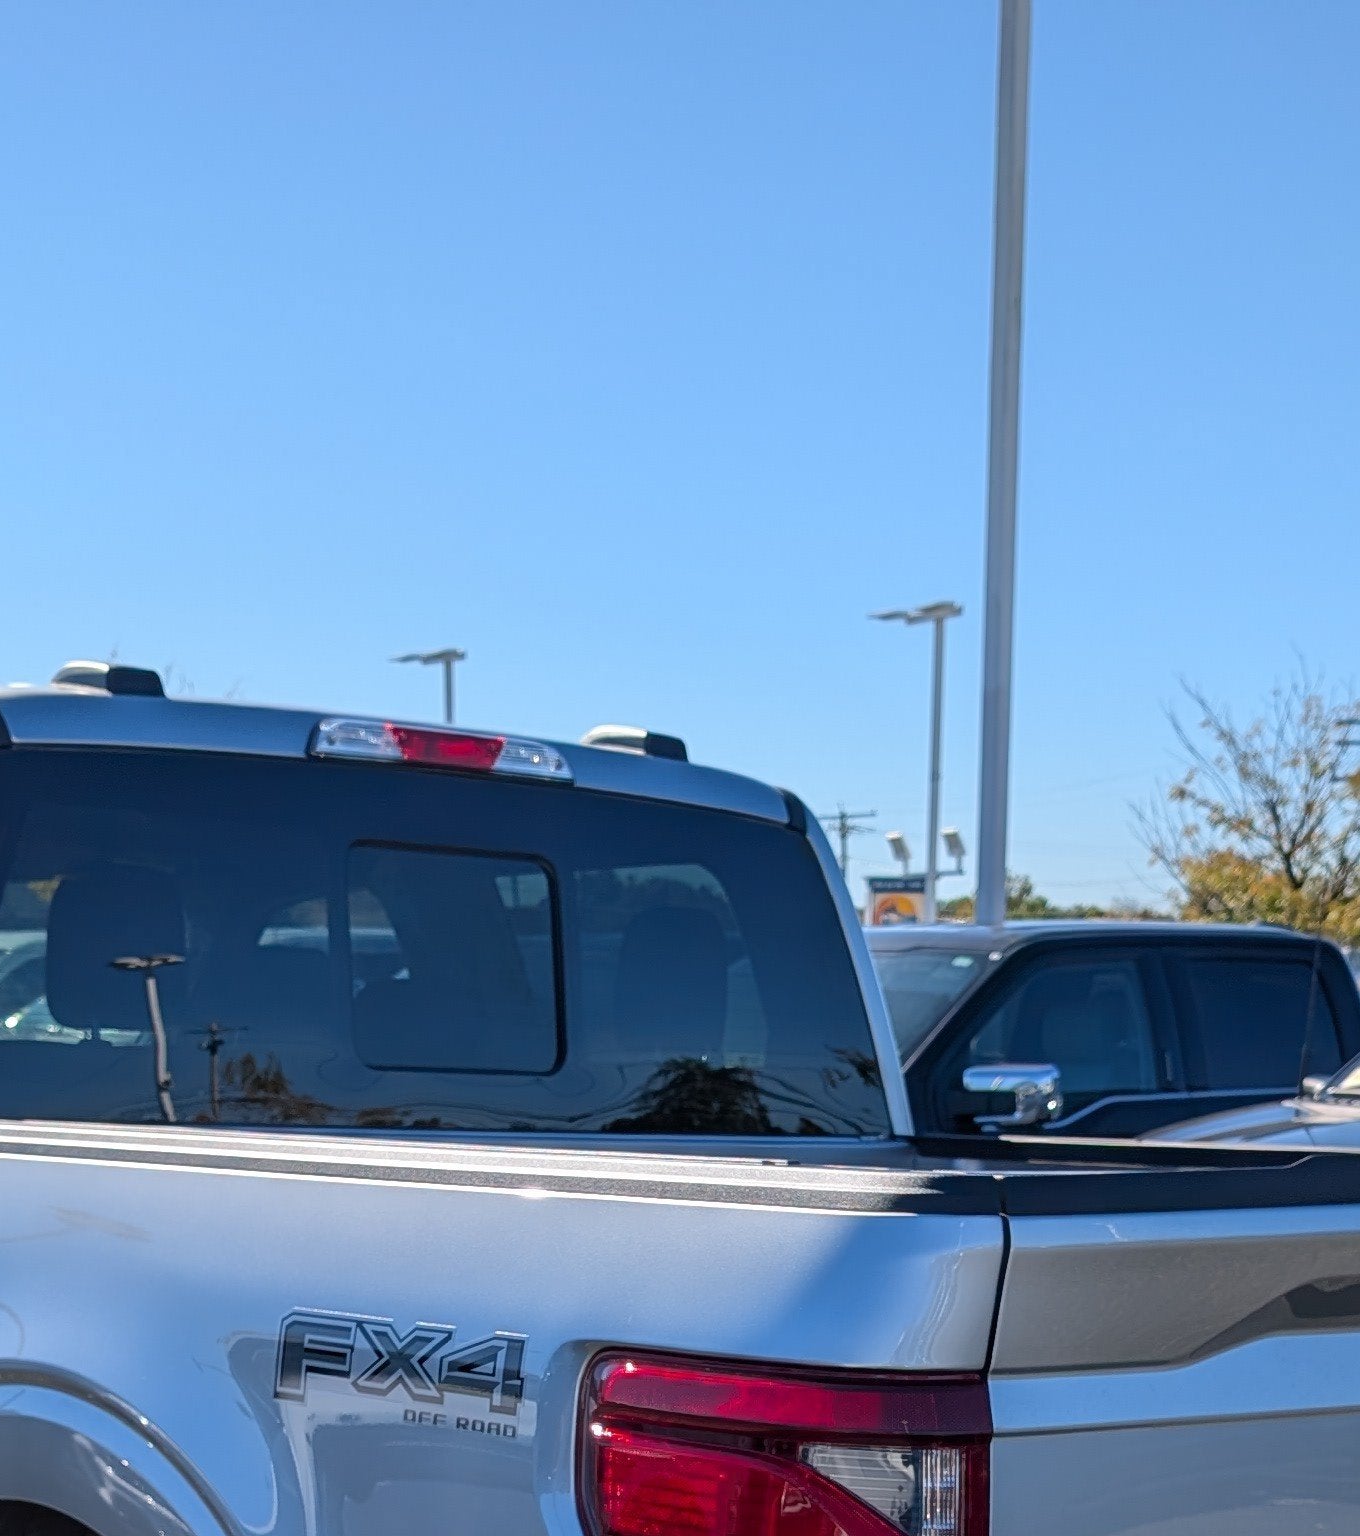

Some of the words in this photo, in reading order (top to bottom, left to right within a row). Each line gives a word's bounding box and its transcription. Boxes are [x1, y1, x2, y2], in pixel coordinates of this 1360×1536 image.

[273, 1307, 528, 1416] FX4
[403, 1408, 447, 1428] OFF
[456, 1417, 517, 1438] ROAD
